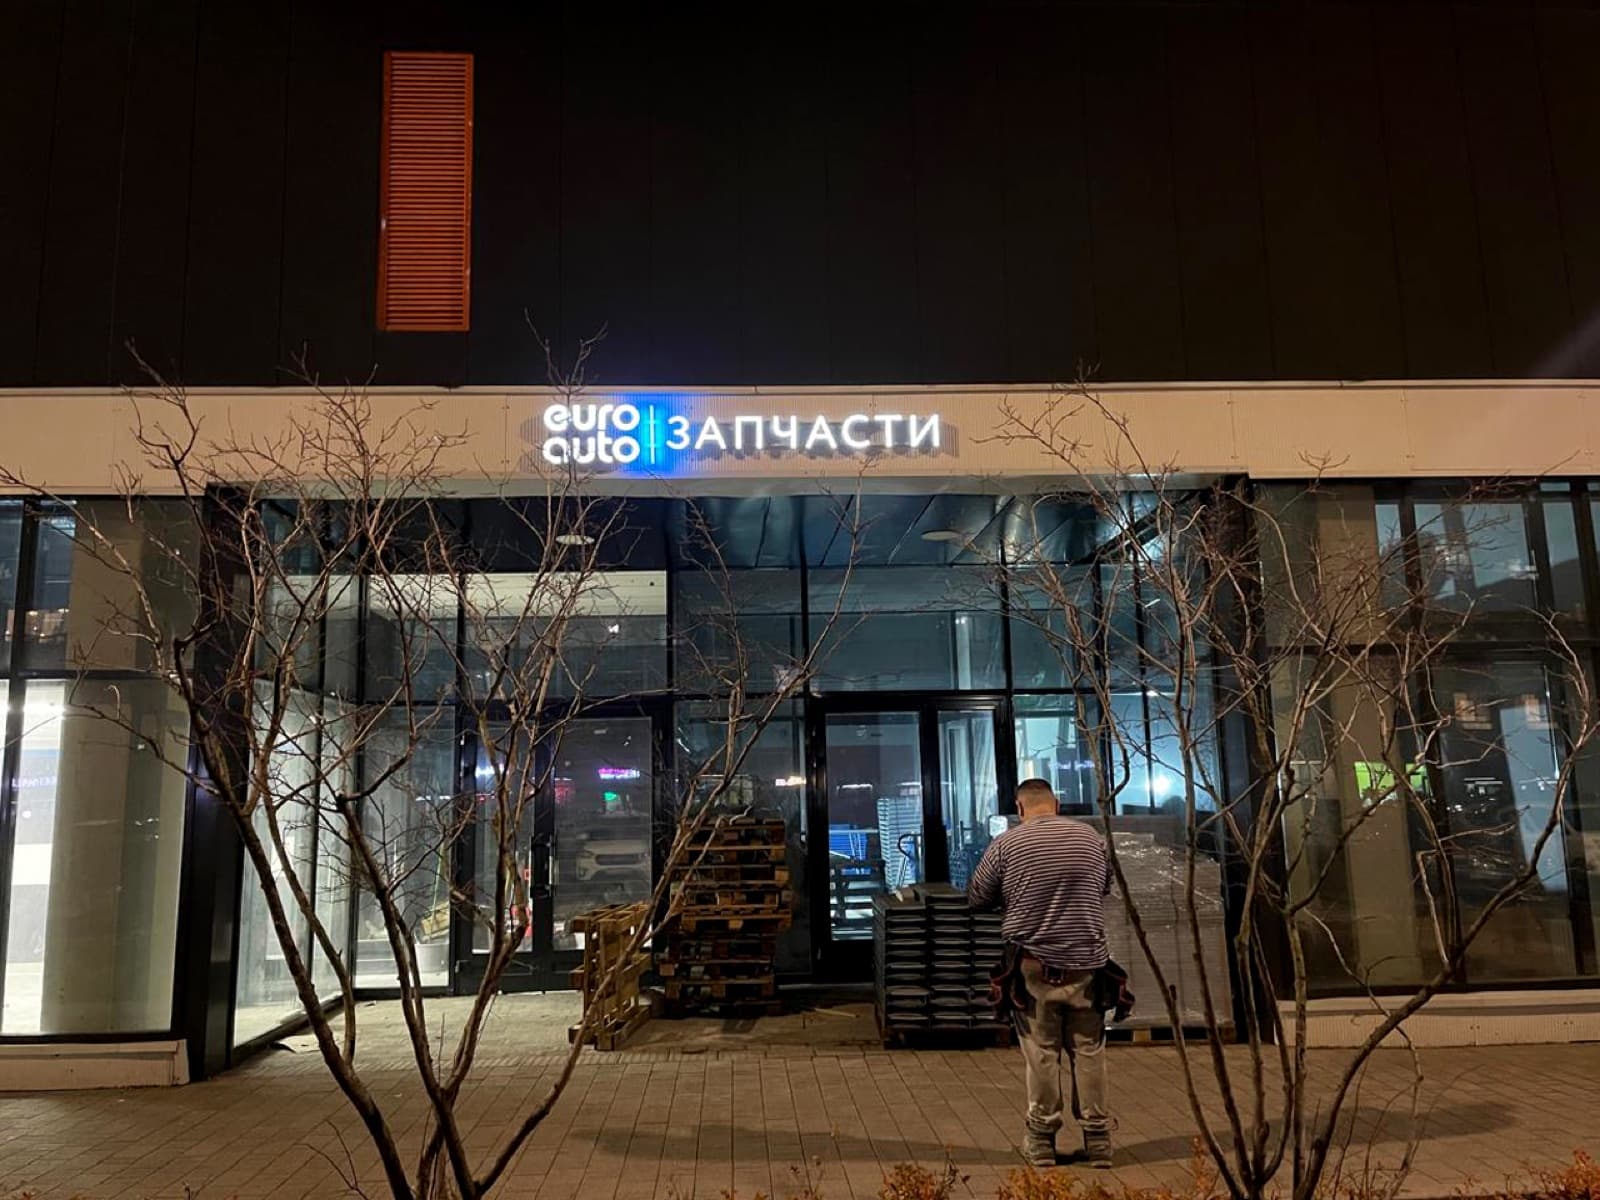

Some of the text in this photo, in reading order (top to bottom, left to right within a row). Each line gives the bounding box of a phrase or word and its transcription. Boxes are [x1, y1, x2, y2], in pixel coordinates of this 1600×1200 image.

[543, 403, 640, 432] euro
[666, 413, 941, 451] ЗАПЧАСТИ
[542, 434, 640, 465] auto
